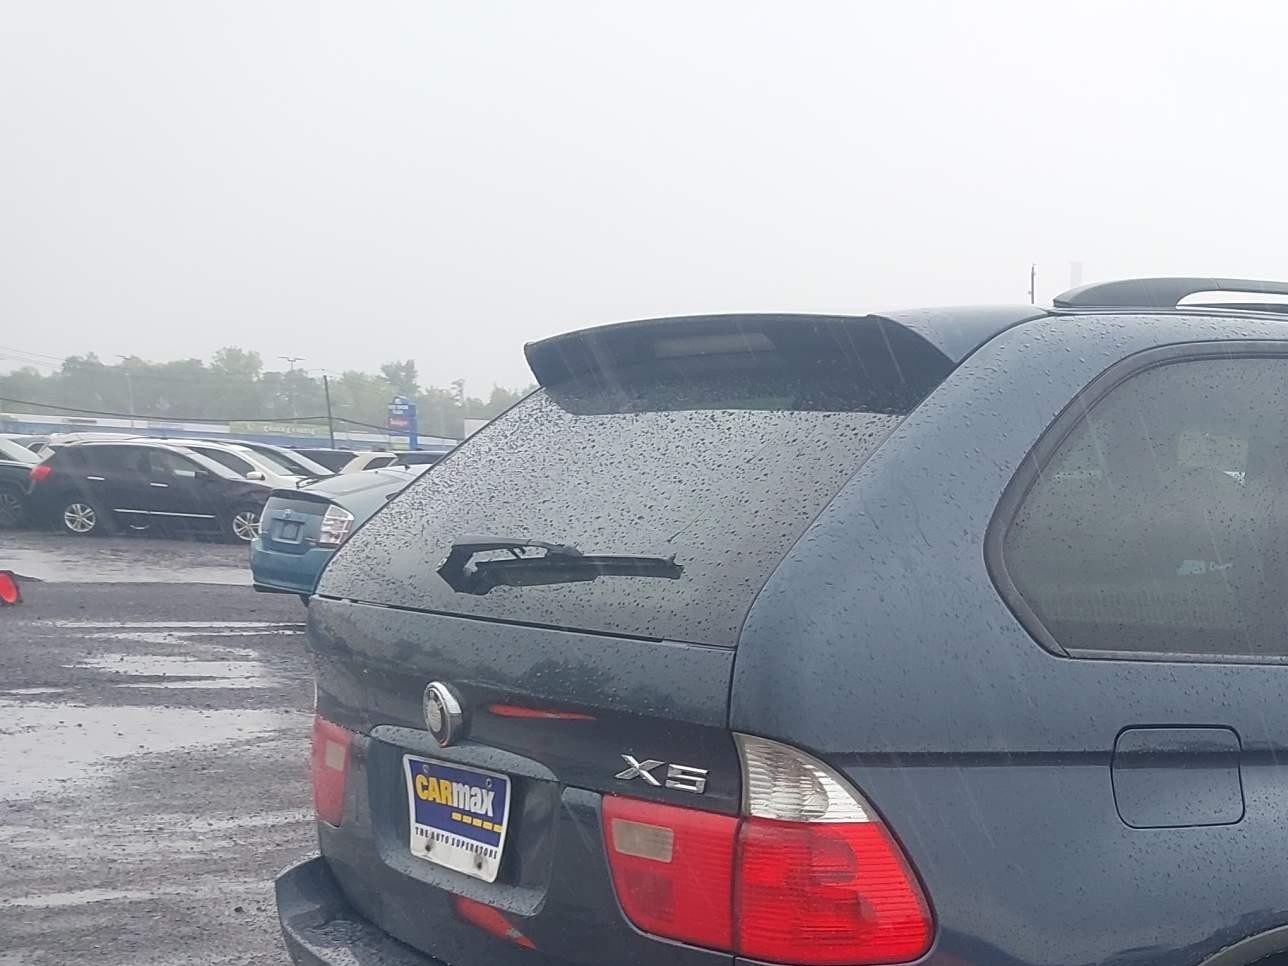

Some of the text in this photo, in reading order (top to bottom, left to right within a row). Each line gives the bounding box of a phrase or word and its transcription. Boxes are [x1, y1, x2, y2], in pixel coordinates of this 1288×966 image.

[614, 754, 708, 794] X5
[415, 827, 498, 860] THE AUTO SUPERSTORE
